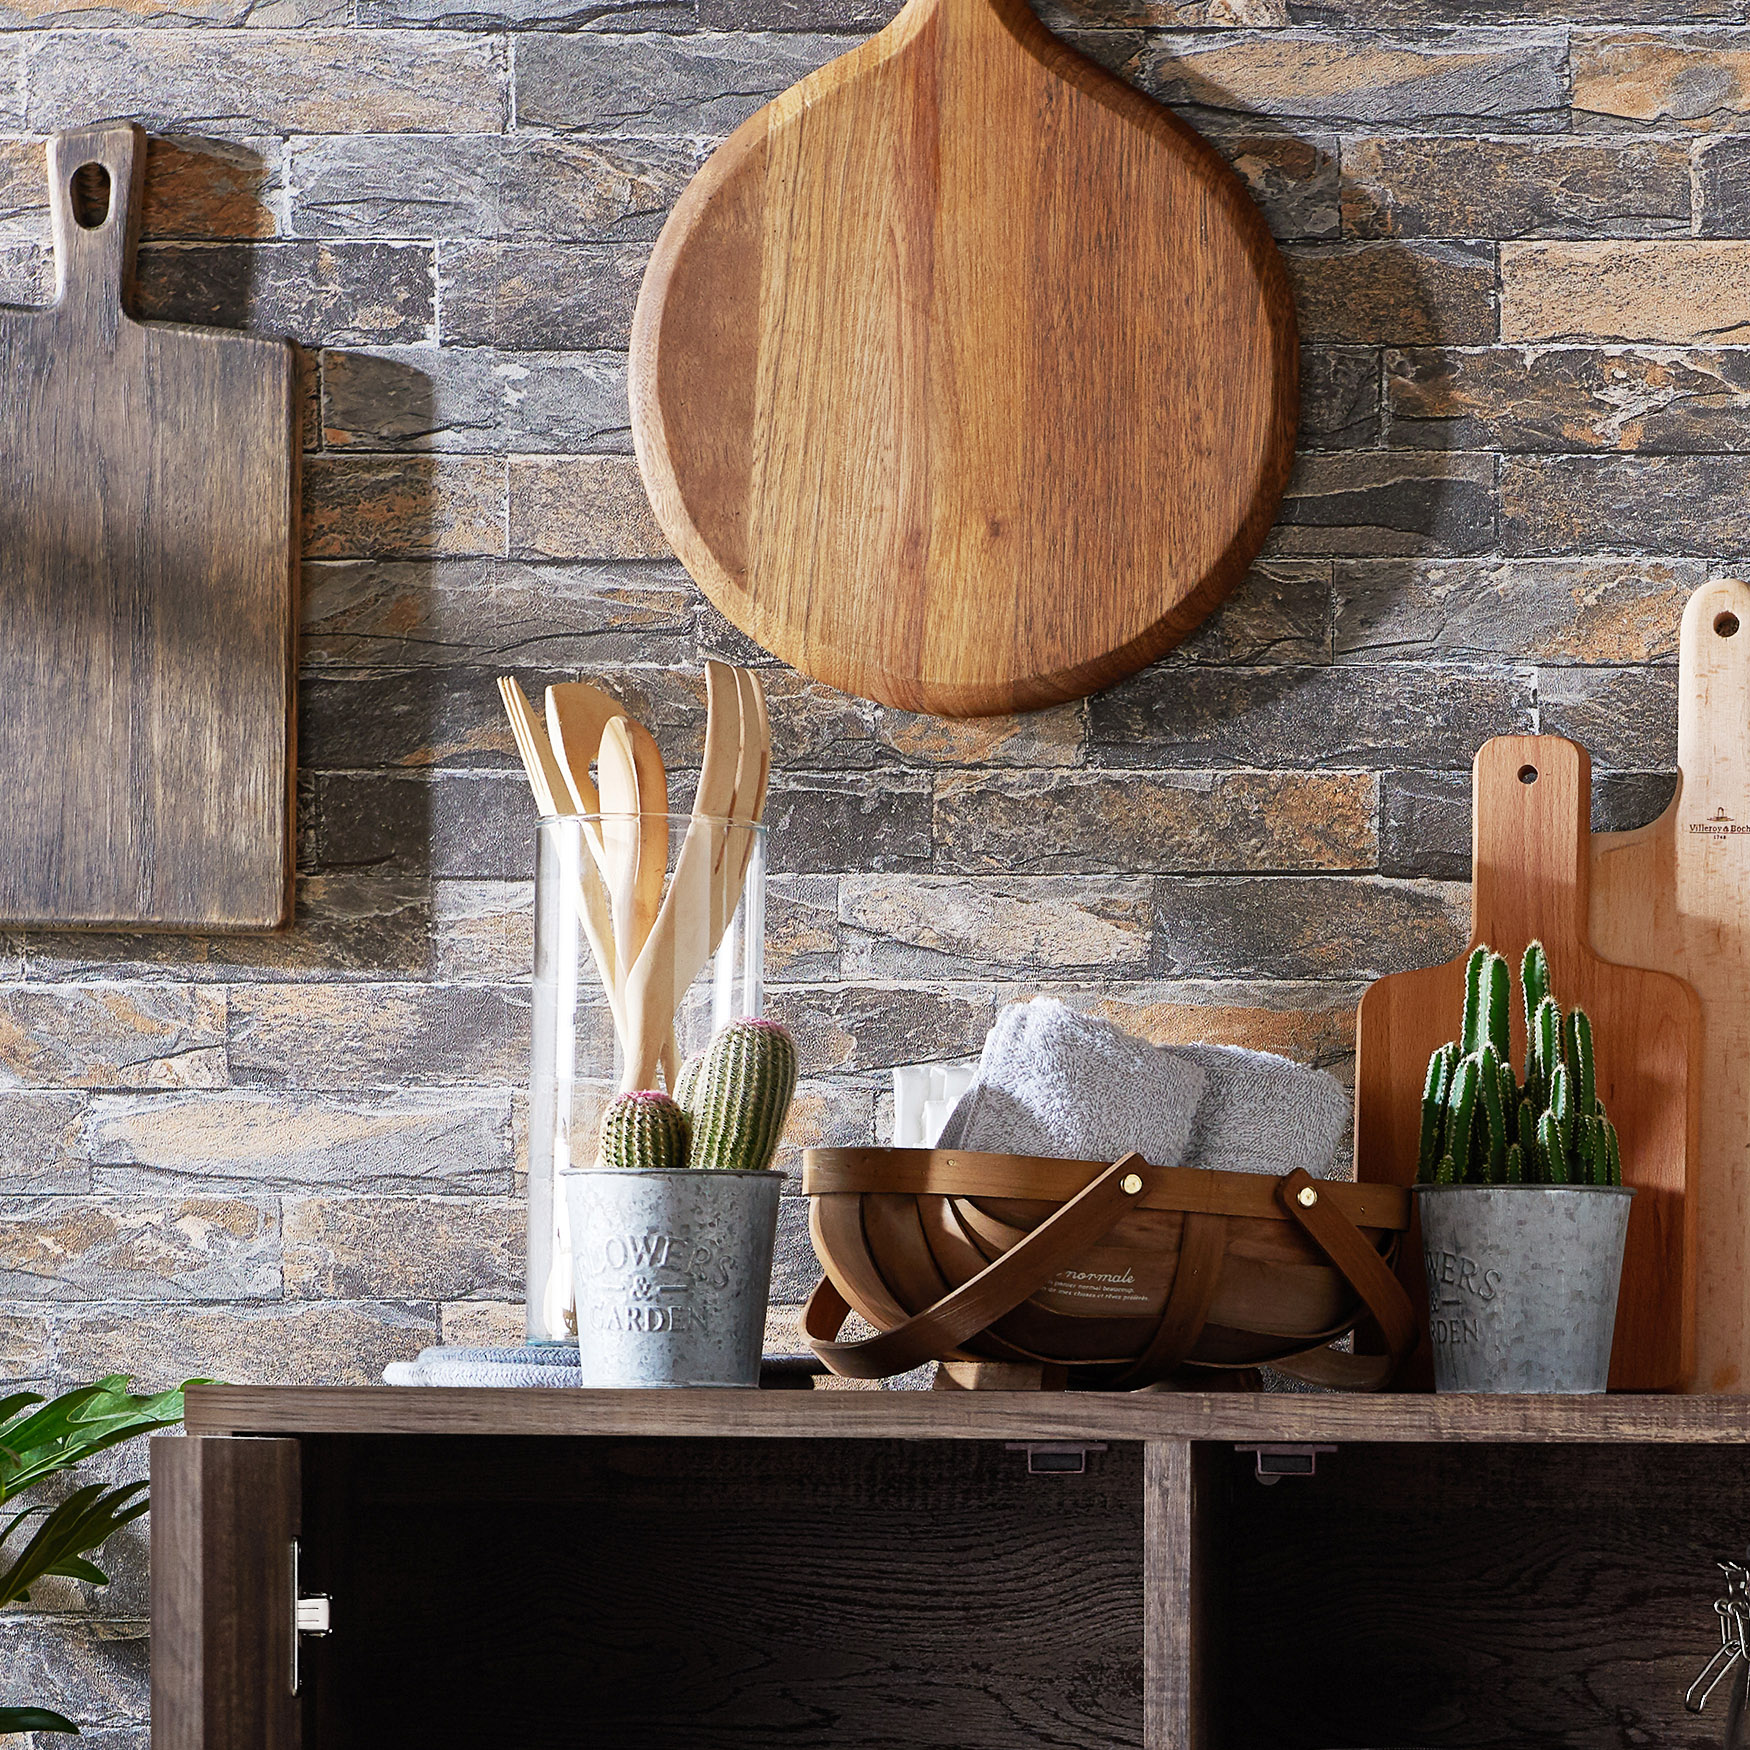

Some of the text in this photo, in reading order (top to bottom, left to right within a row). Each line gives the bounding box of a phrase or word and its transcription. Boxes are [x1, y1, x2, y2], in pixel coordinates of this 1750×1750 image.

[1689, 824, 1722, 834] Villeroy
[1730, 825, 1750, 833] Boch
[630, 1274, 652, 1301] &
[1065, 1266, 1136, 1284] normale
[1425, 1249, 1502, 1301] WERS
[590, 1305, 709, 1332] GARDEN
[1430, 1318, 1479, 1344] RDEN
